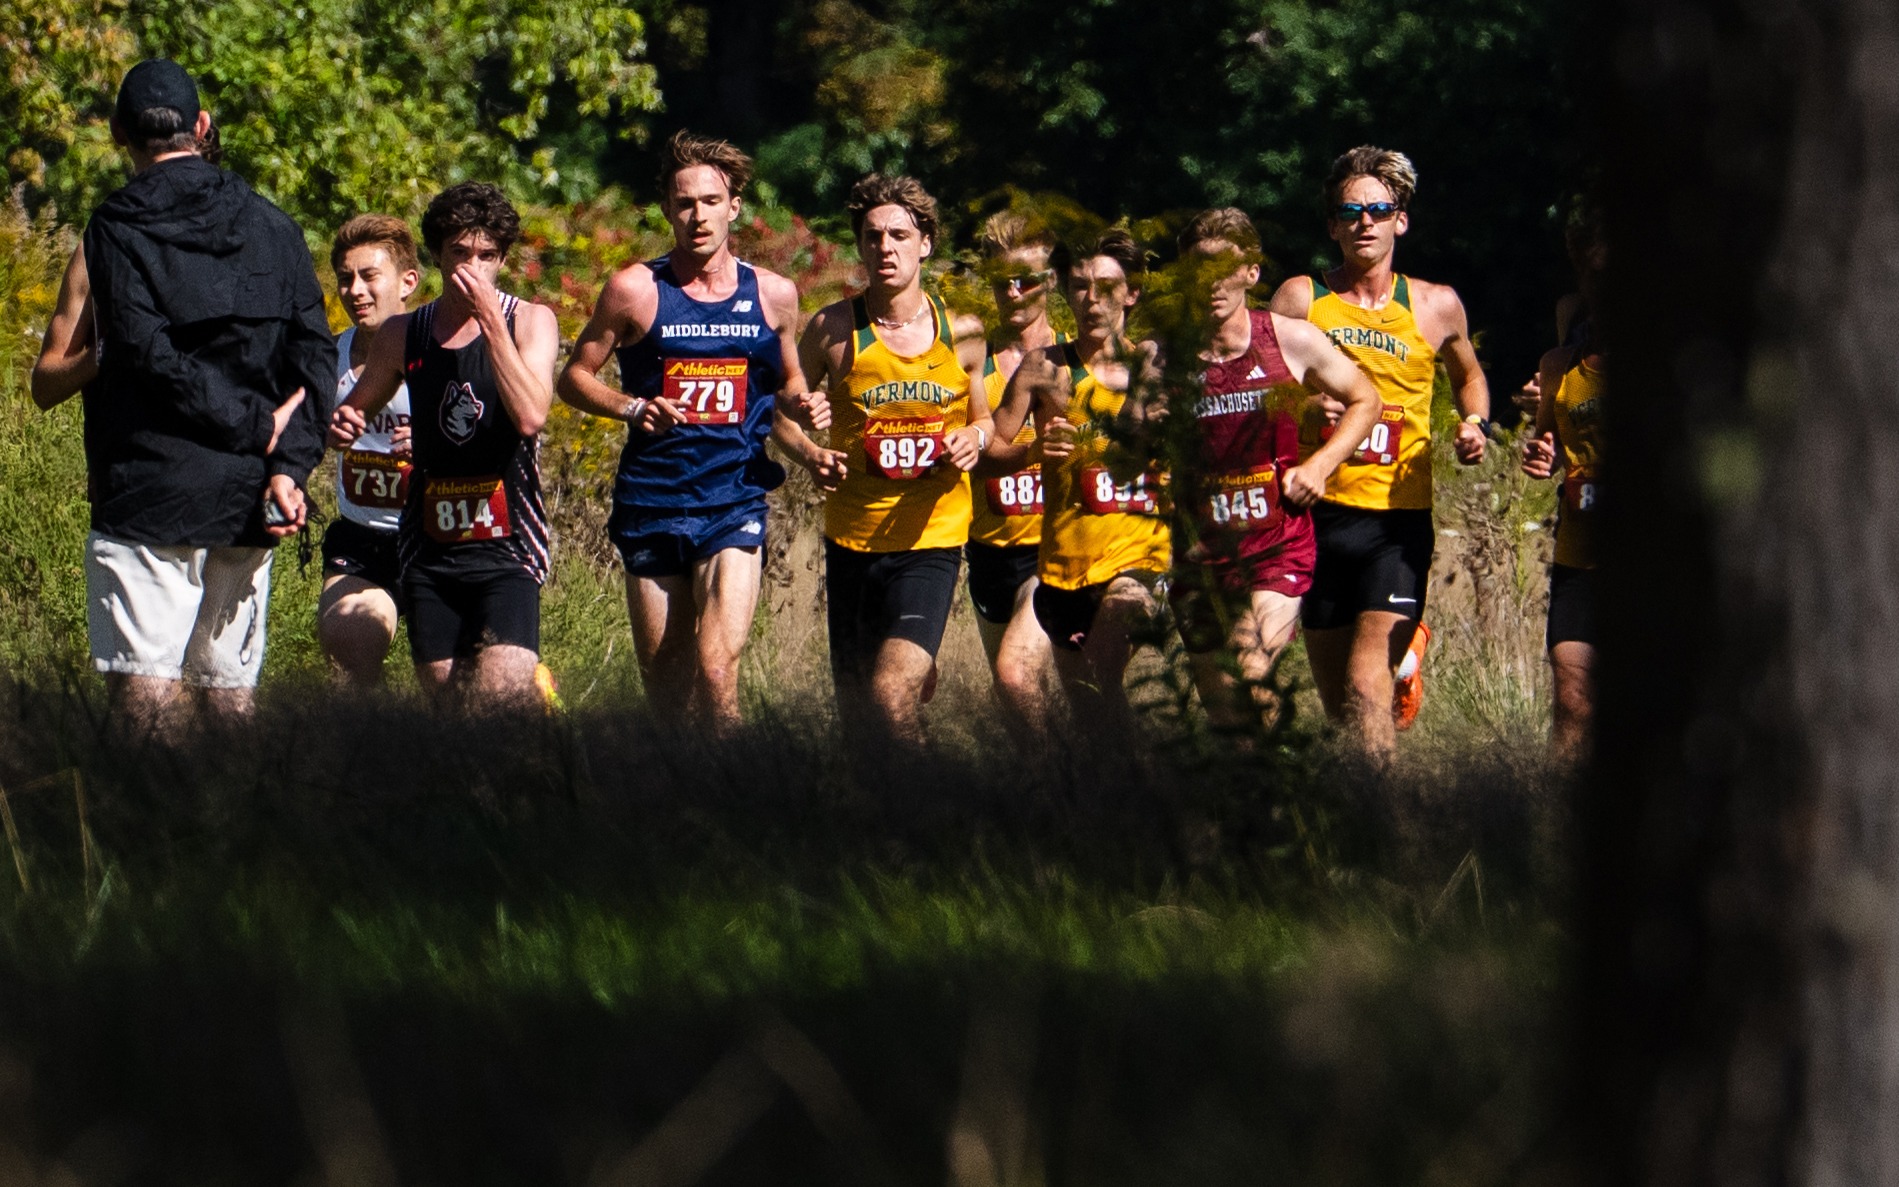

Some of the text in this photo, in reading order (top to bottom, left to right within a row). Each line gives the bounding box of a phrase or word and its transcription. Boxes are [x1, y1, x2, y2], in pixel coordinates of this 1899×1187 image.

[661, 323, 761, 338] MIDDLEBURY
[1325, 327, 1409, 363] ERMONT
[678, 380, 734, 412] 779
[861, 381, 955, 412] VERMONT
[880, 437, 935, 469] 892
[351, 467, 402, 499] 737
[436, 498, 494, 531] 814
[1210, 487, 1268, 523] 845
